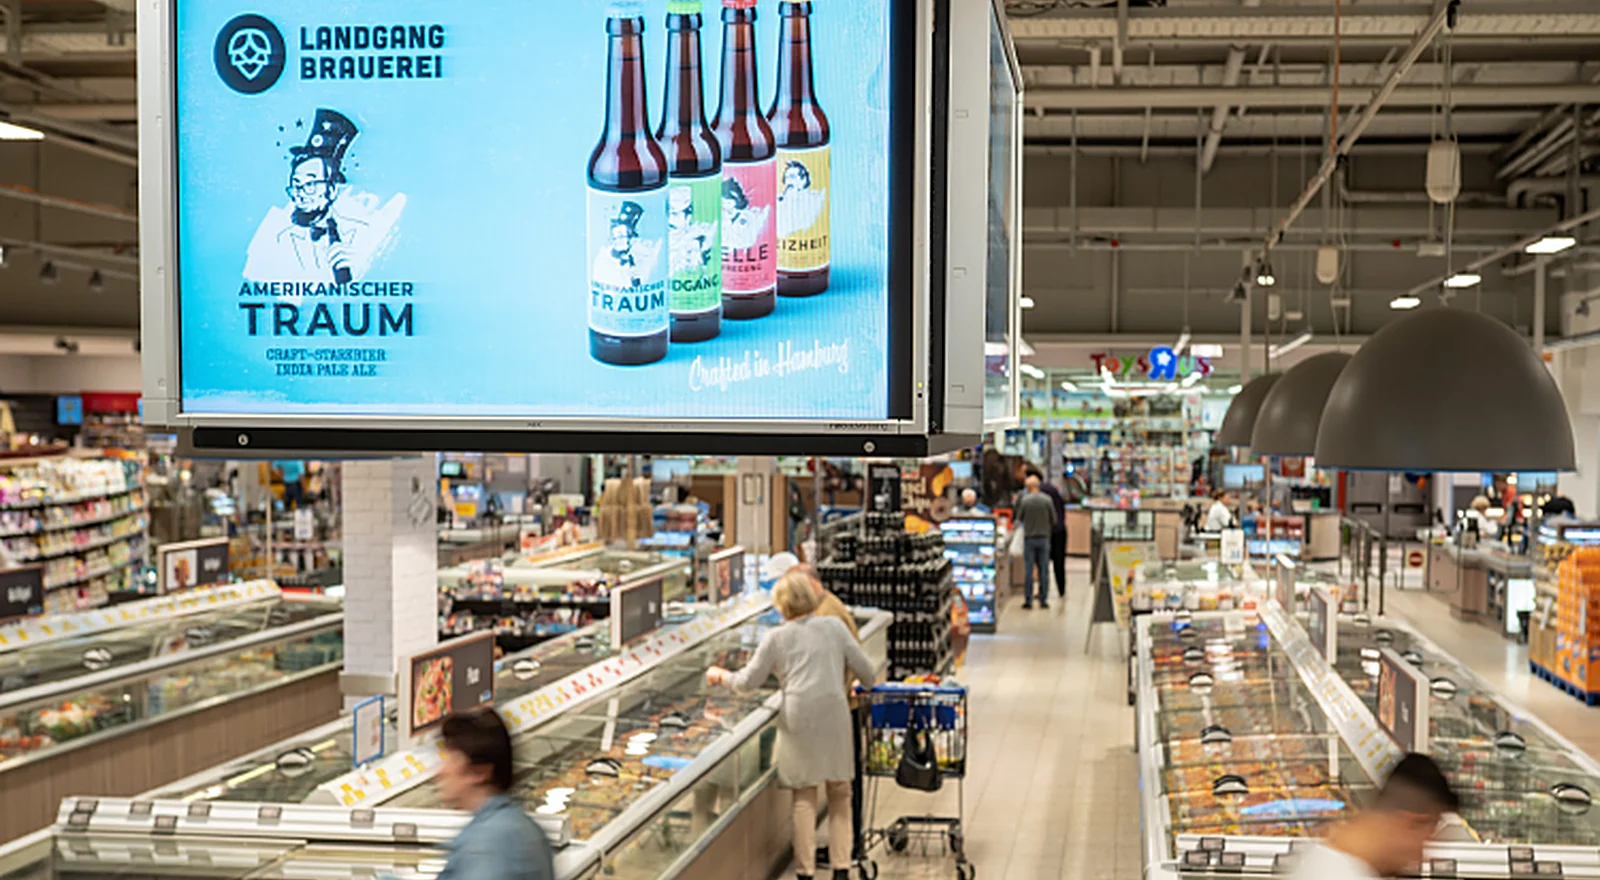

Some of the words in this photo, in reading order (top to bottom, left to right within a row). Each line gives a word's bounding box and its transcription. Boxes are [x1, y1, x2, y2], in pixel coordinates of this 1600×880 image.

[300, 25, 445, 50] LANDGANG
[300, 55, 443, 80] BRAUEREI
[239, 281, 414, 297] AMERIKANISCHER
[591, 290, 665, 313] TRAUM
[239, 302, 413, 337] TRAUM
[266, 348, 386, 362] CRAFT-STARKBIER
[688, 355, 751, 392] Crafted
[753, 350, 770, 377] in
[772, 338, 851, 374] Hamburg
[276, 363, 313, 376] INDIA
[317, 363, 349, 376] PALE
[352, 363, 377, 376] ALE
